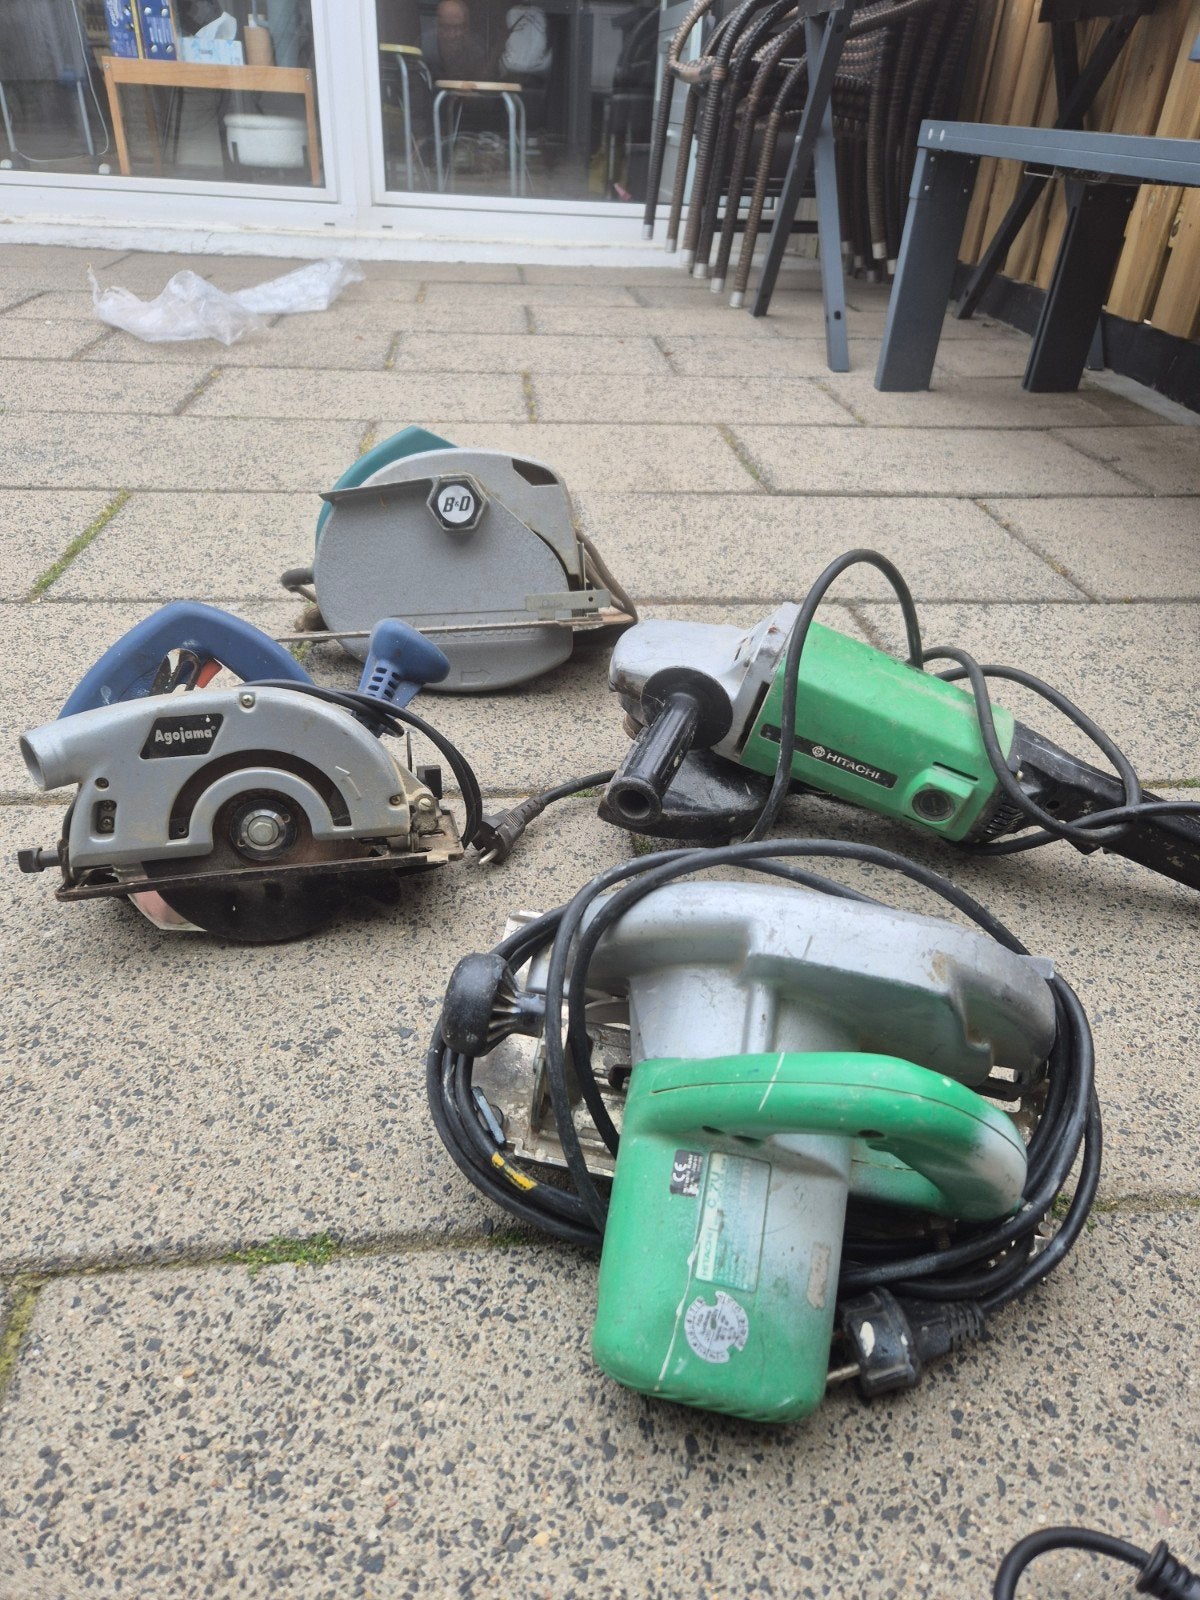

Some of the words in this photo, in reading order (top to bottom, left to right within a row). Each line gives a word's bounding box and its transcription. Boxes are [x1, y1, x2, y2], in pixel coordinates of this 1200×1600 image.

[443, 496, 471, 512] B&D
[155, 727, 213, 745] Agojama
[826, 752, 880, 779] HITACHI
[672, 1162, 687, 1182] CE
